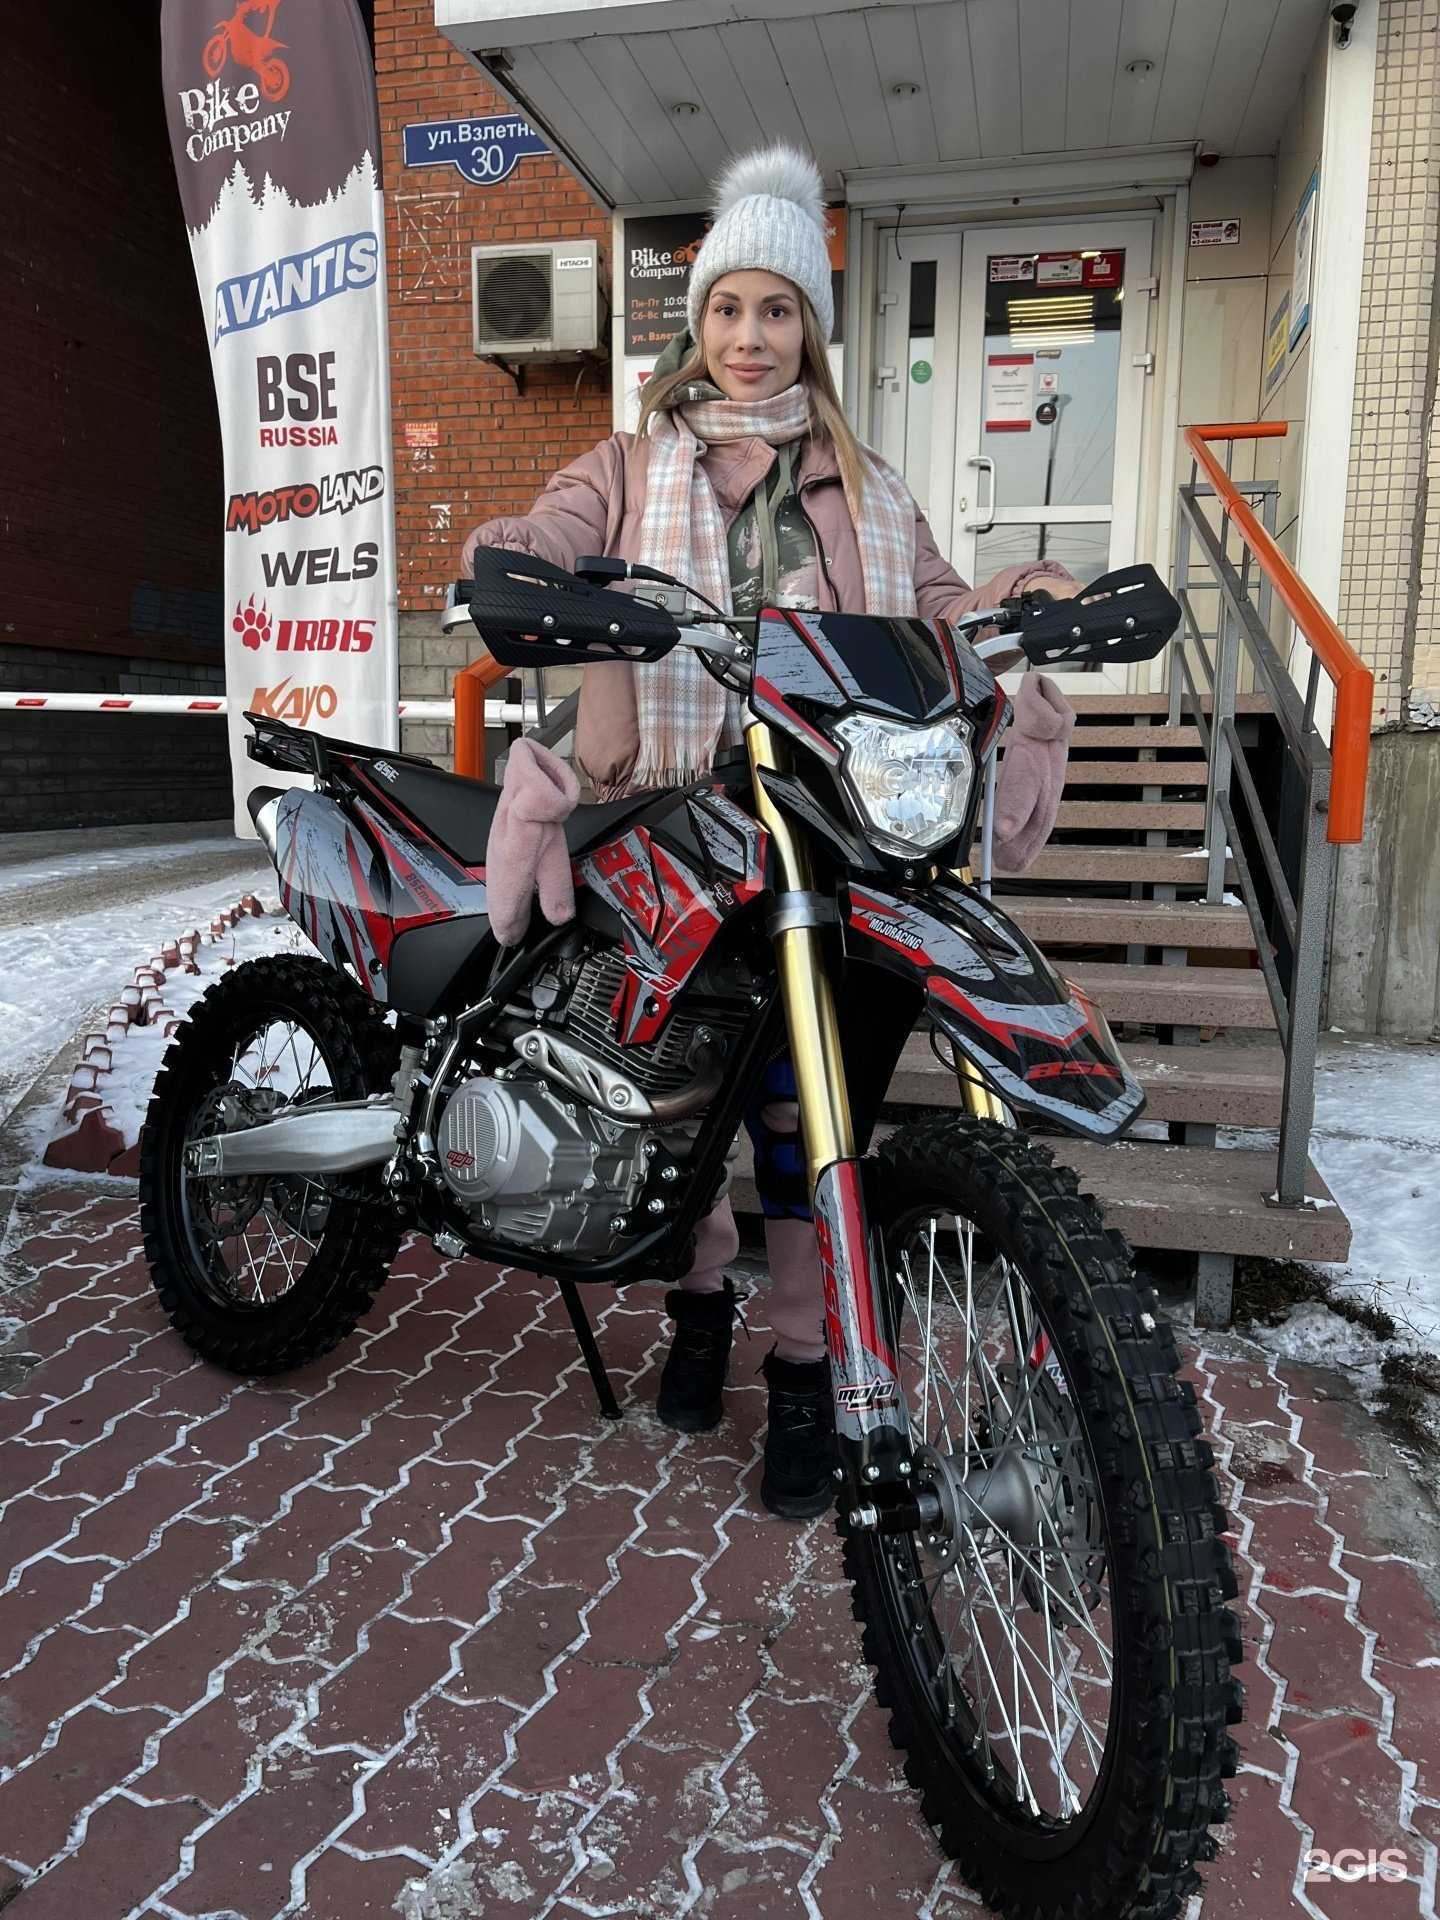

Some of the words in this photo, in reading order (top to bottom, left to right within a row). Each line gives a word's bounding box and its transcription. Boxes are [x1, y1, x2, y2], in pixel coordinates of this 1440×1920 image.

[178, 78, 260, 131] Bike
[185, 110, 292, 162] Company
[471, 144, 504, 177] 30
[630, 265, 688, 280] Company
[631, 247, 672, 269] Bike
[214, 232, 379, 348] AVANTIS
[256, 351, 338, 423] BSE
[260, 425, 338, 448] RUSSIA
[261, 542, 379, 588] WELS
[275, 619, 376, 653] IRBIS
[373, 760, 400, 783] BSE
[868, 918, 923, 950] MOJORACING
